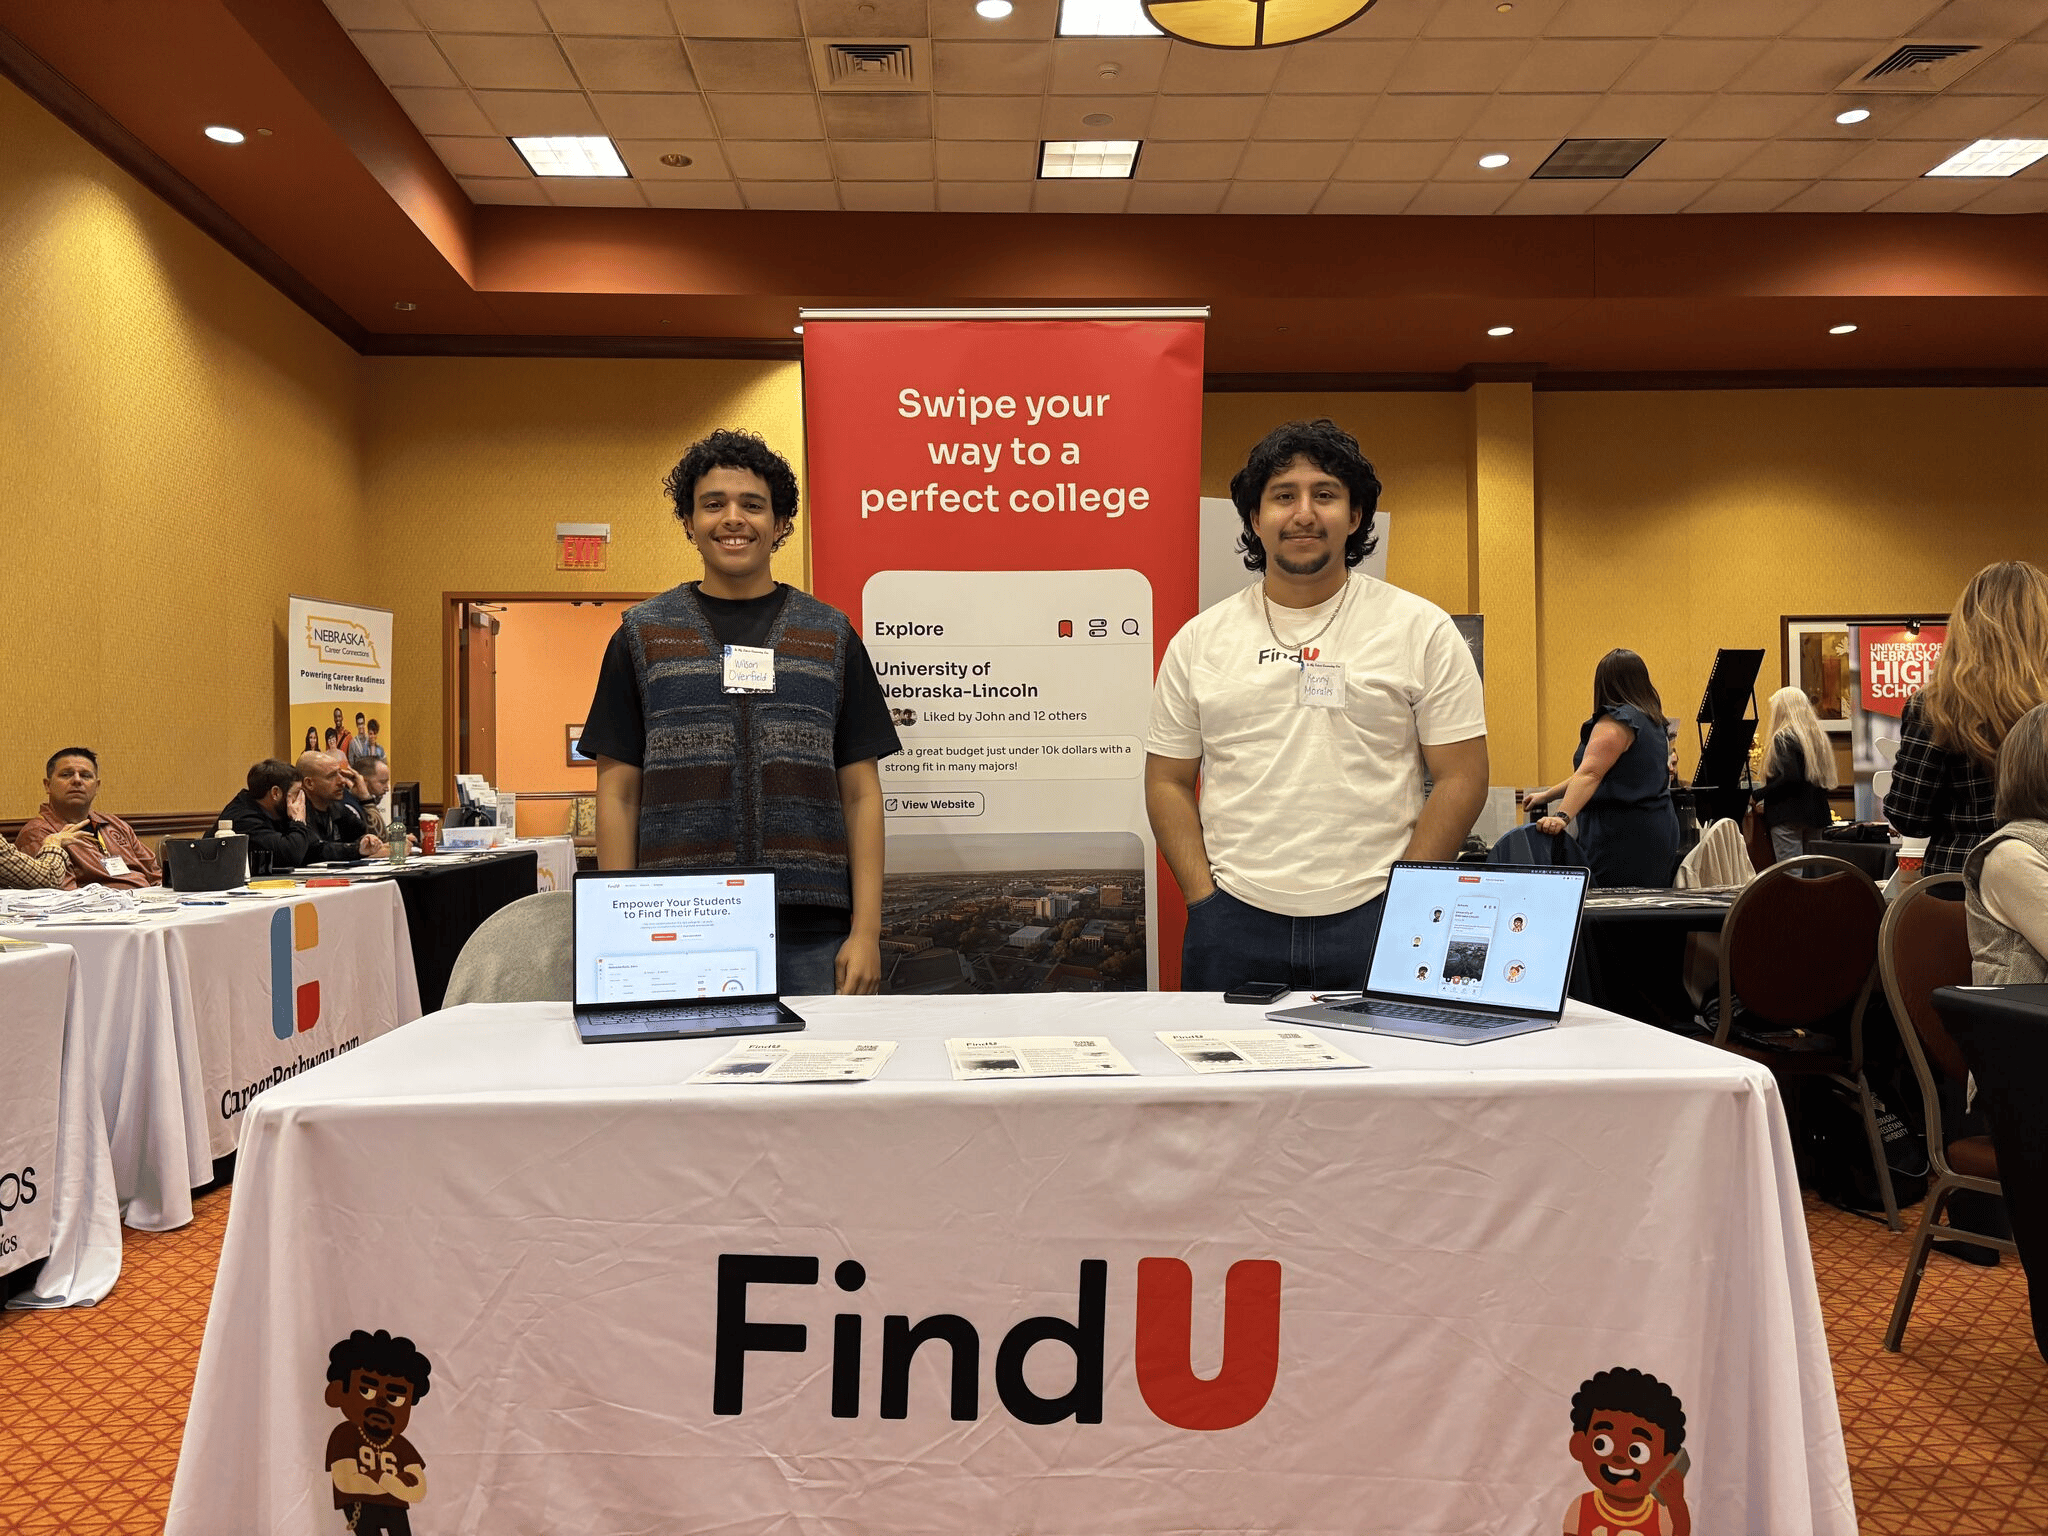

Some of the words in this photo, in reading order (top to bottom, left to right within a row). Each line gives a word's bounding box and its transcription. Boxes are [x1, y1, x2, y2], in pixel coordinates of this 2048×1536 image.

[898, 388, 1016, 425] Swipe
[1025, 393, 1110, 425] your
[928, 442, 1002, 473] way
[1010, 437, 1051, 465] to
[1060, 442, 1080, 465] a
[861, 483, 999, 519] perfect
[1009, 483, 1149, 518] college
[564, 537, 601, 561] EXIT
[314, 628, 366, 647] NEBRASKA
[875, 621, 944, 639] Explore
[324, 645, 341, 653] Career
[342, 647, 369, 658] Connections
[1870, 642, 1927, 651] UNIVERSITY
[1929, 643, 1943, 651] OF
[1258, 647, 1320, 664] FindU
[1870, 651, 1941, 661] NEBRASKA
[300, 669, 332, 681] Powering
[333, 672, 354, 682] Career
[355, 674, 385, 685] Readiness
[875, 661, 967, 679] University
[972, 660, 991, 676] of
[326, 682, 332, 690] in
[333, 683, 364, 693] Nebraska
[1871, 684, 1921, 698] SCHO
[923, 711, 955, 722] Liked
[958, 711, 972, 725] by
[975, 711, 1005, 722] John
[1008, 711, 1031, 722] and
[1033, 711, 1045, 721] 12
[1048, 710, 1087, 722] others
[907, 748, 913, 756] a
[915, 746, 943, 758] great
[946, 746, 984, 759] budget
[986, 745, 1006, 758] just
[1008, 745, 1039, 756] under
[1042, 745, 1059, 755] 10k
[1062, 744, 1097, 755] dollars
[1099, 744, 1123, 754] with
[1125, 746, 1131, 754] a
[885, 763, 920, 774] strong
[922, 762, 934, 771] fit
[936, 762, 946, 771] in
[948, 763, 976, 773] many
[978, 761, 1018, 773] majors!
[902, 800, 927, 810] View
[930, 799, 975, 810] Website
[612, 899, 664, 912] Empower
[666, 898, 692, 908] Your
[693, 896, 742, 907] Students
[624, 909, 636, 919] to
[638, 908, 662, 918] Find
[664, 907, 691, 918] Their
[694, 906, 731, 917] Future.
[713, 1253, 1282, 1431] FindU
